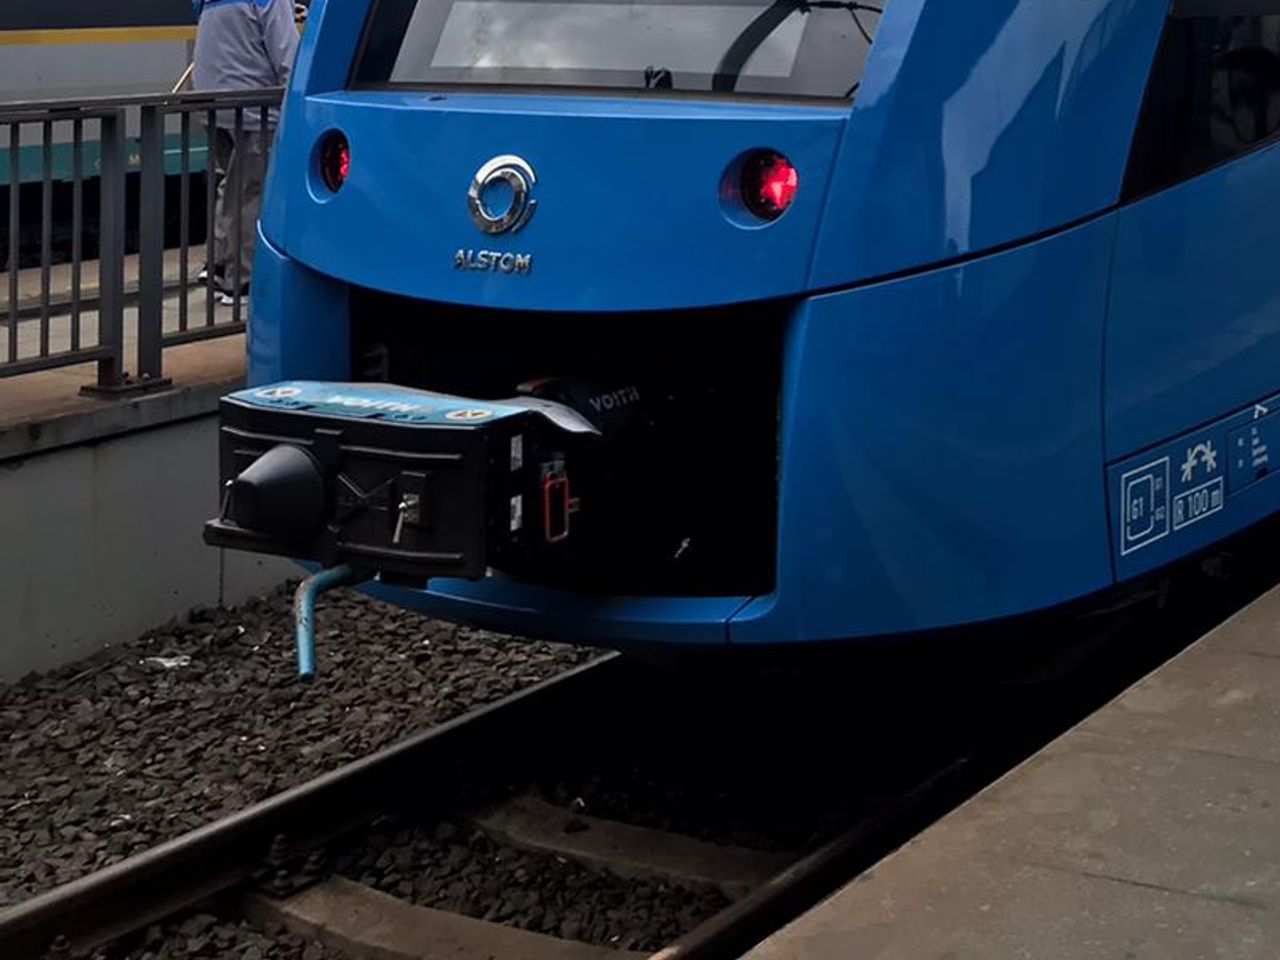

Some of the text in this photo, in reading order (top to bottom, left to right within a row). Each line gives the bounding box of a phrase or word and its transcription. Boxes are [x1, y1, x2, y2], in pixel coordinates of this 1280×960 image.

[453, 249, 533, 275] ALSTOM
[589, 385, 640, 414] VOITH
[1188, 489, 1209, 518] 100
